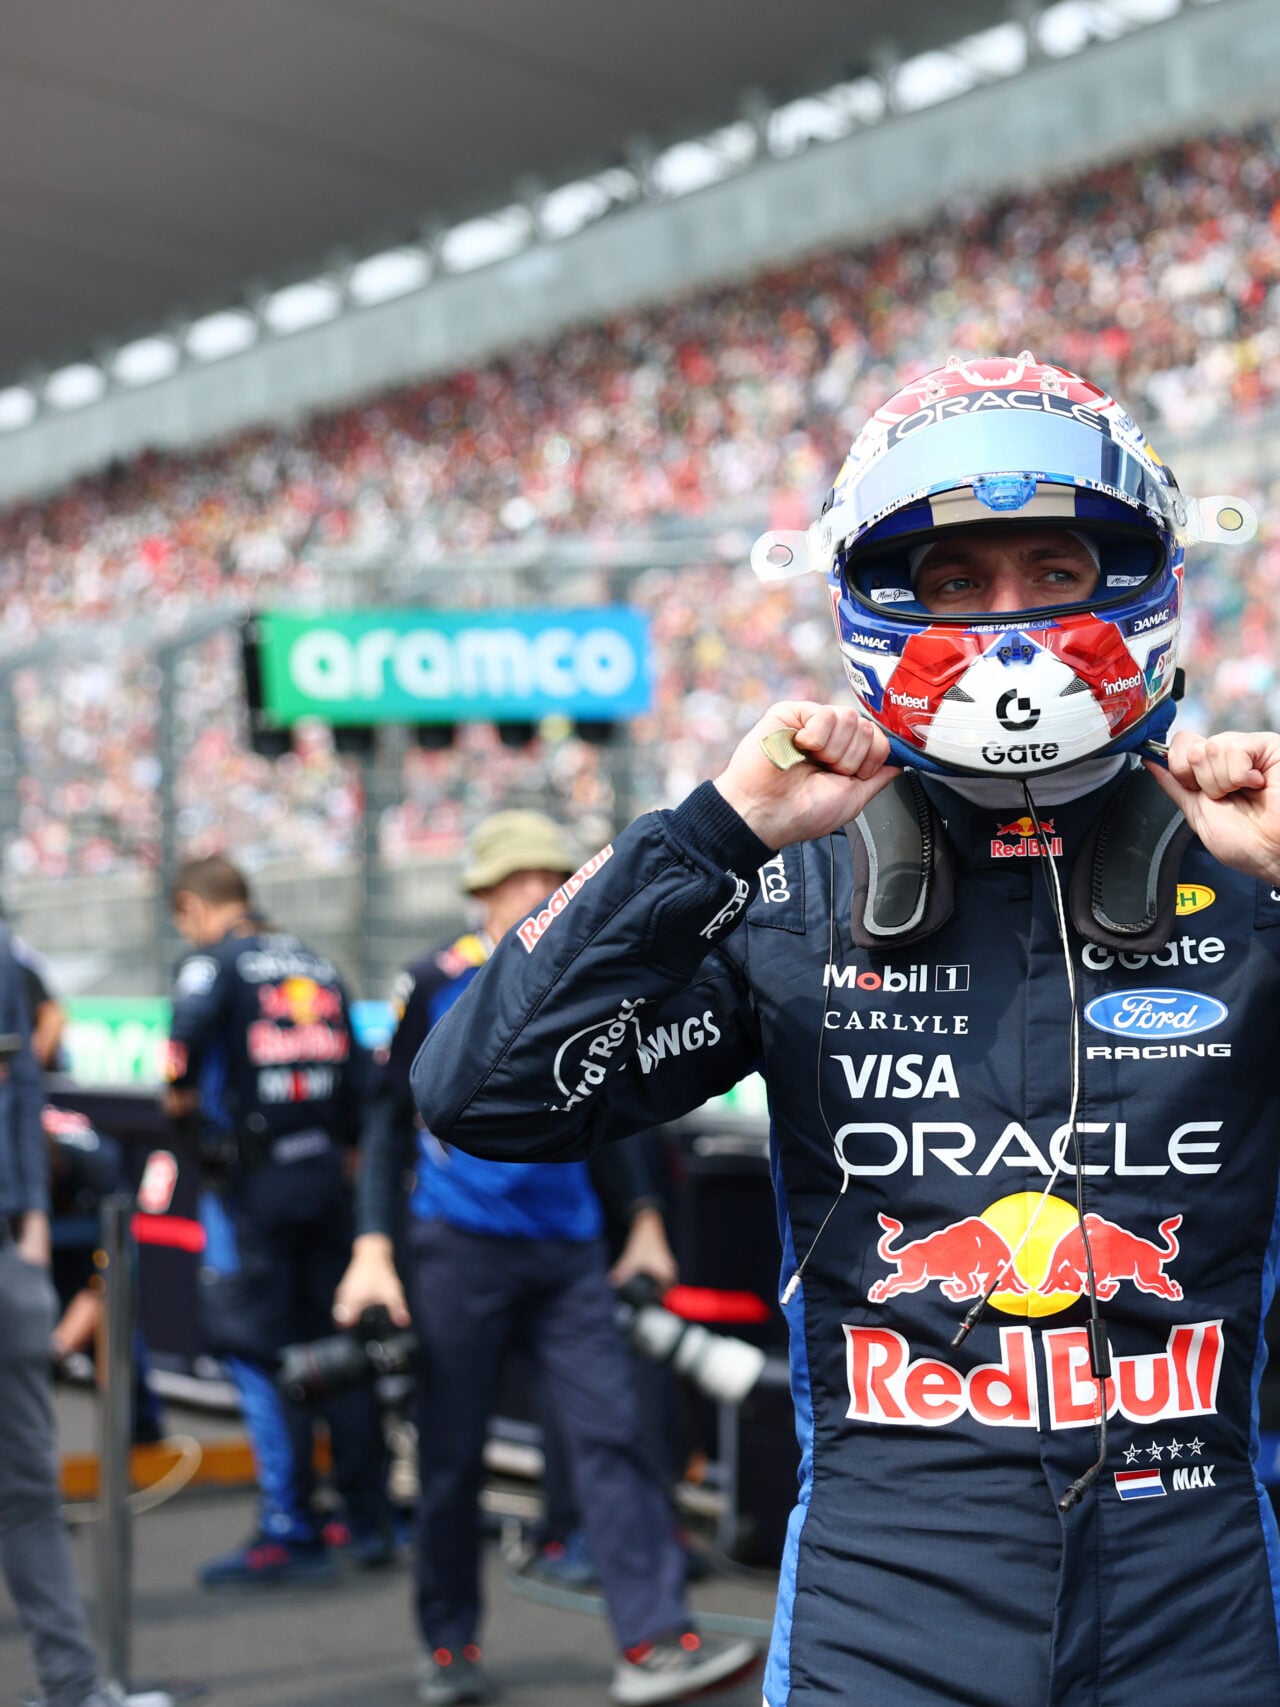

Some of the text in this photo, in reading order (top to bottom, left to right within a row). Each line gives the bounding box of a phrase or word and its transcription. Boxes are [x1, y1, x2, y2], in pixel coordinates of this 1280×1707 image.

[896, 391, 1103, 438] ORACLE
[970, 619, 1052, 634] VERSTAPPEN.COM
[1134, 609, 1169, 632] DAMAC
[851, 632, 890, 650] DAMAC
[289, 627, 637, 701] aramco
[1101, 671, 1141, 696] indeed
[887, 687, 929, 710] indeed
[981, 742, 1060, 765] Gate
[990, 838, 1027, 858] Red
[823, 963, 928, 992] Mobil
[823, 1010, 970, 1035] CARLYLE
[1112, 995, 1199, 1030] Ford
[1086, 1043, 1232, 1060] RACING
[830, 1053, 961, 1099] VISA
[834, 1120, 1224, 1176] ORACLE
[844, 1320, 1223, 1429] Red Bull
[1172, 1464, 1217, 1491] MAX
